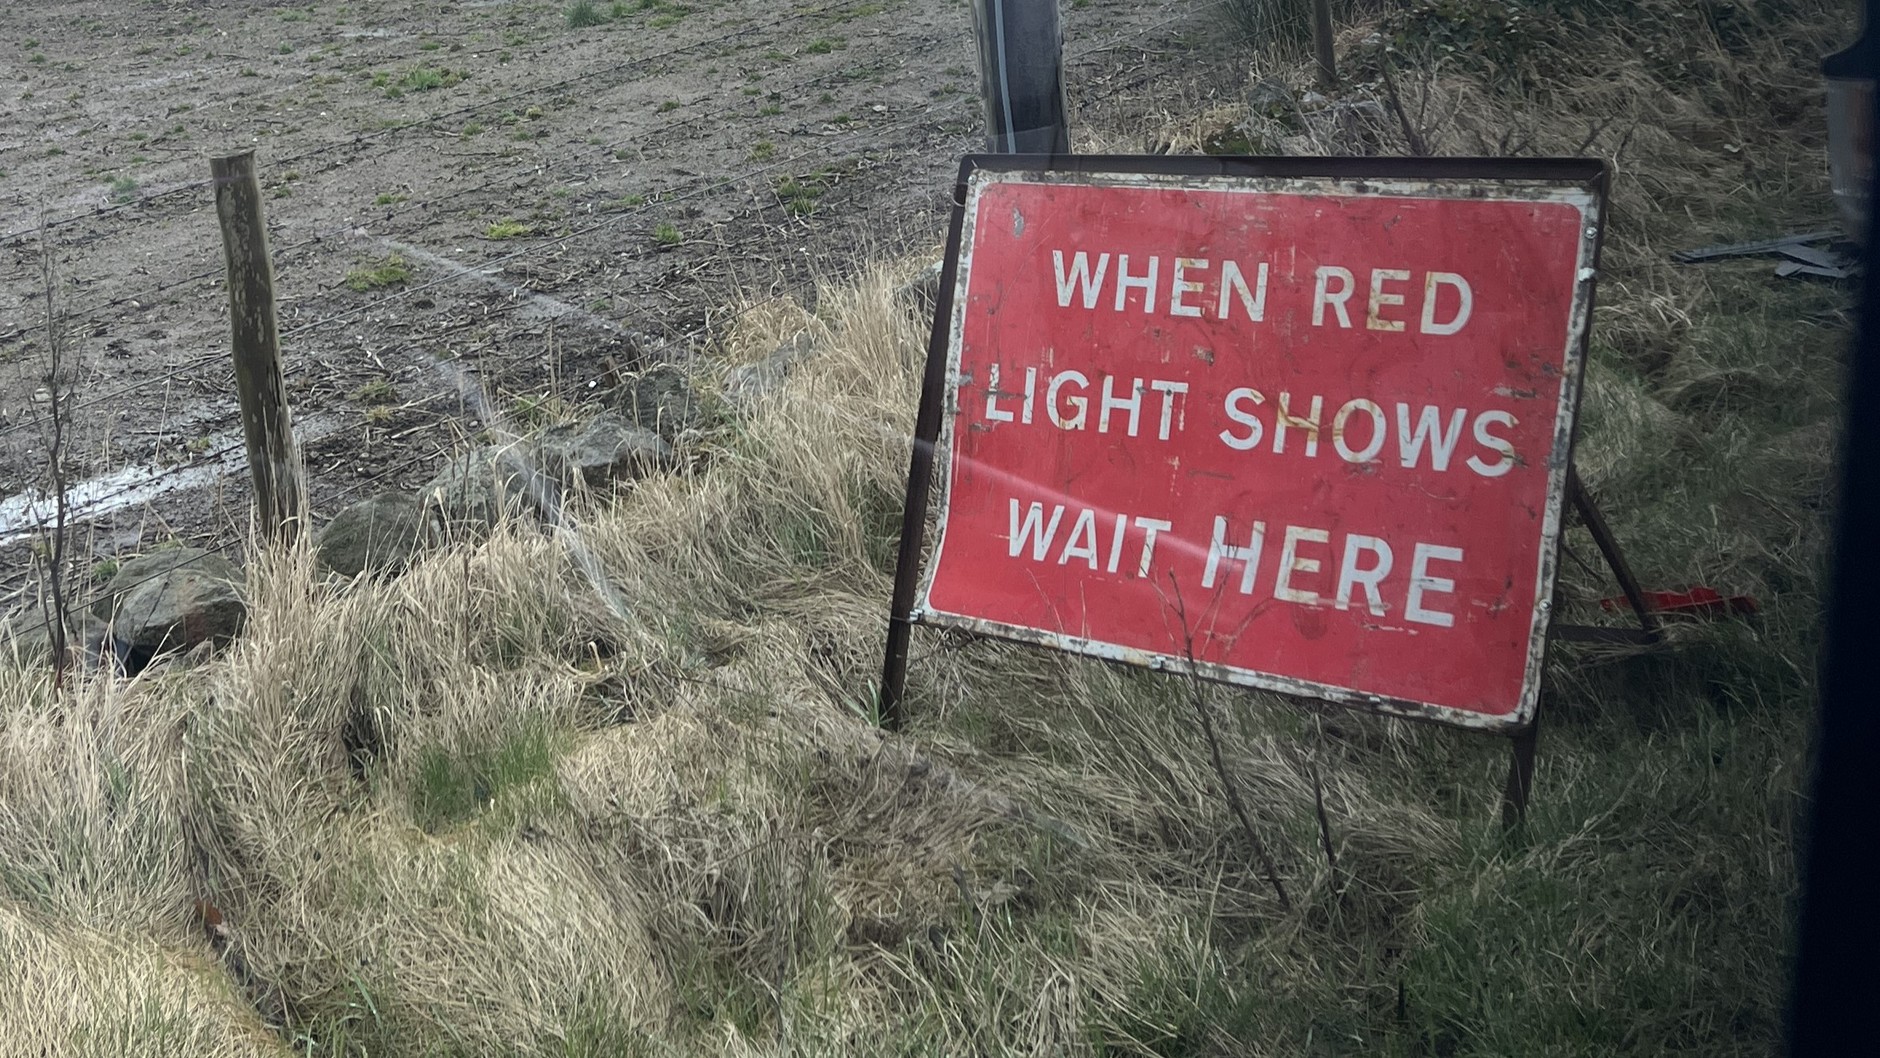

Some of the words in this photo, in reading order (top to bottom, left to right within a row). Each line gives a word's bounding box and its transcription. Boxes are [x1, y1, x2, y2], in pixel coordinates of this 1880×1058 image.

[1053, 250, 1269, 322] WHEN
[1311, 266, 1473, 336] RED
[985, 364, 1189, 441] LIGHT
[1218, 387, 1520, 477] SHOWS
[1008, 498, 1172, 578] WAIT
[1201, 515, 1464, 628] HERE
